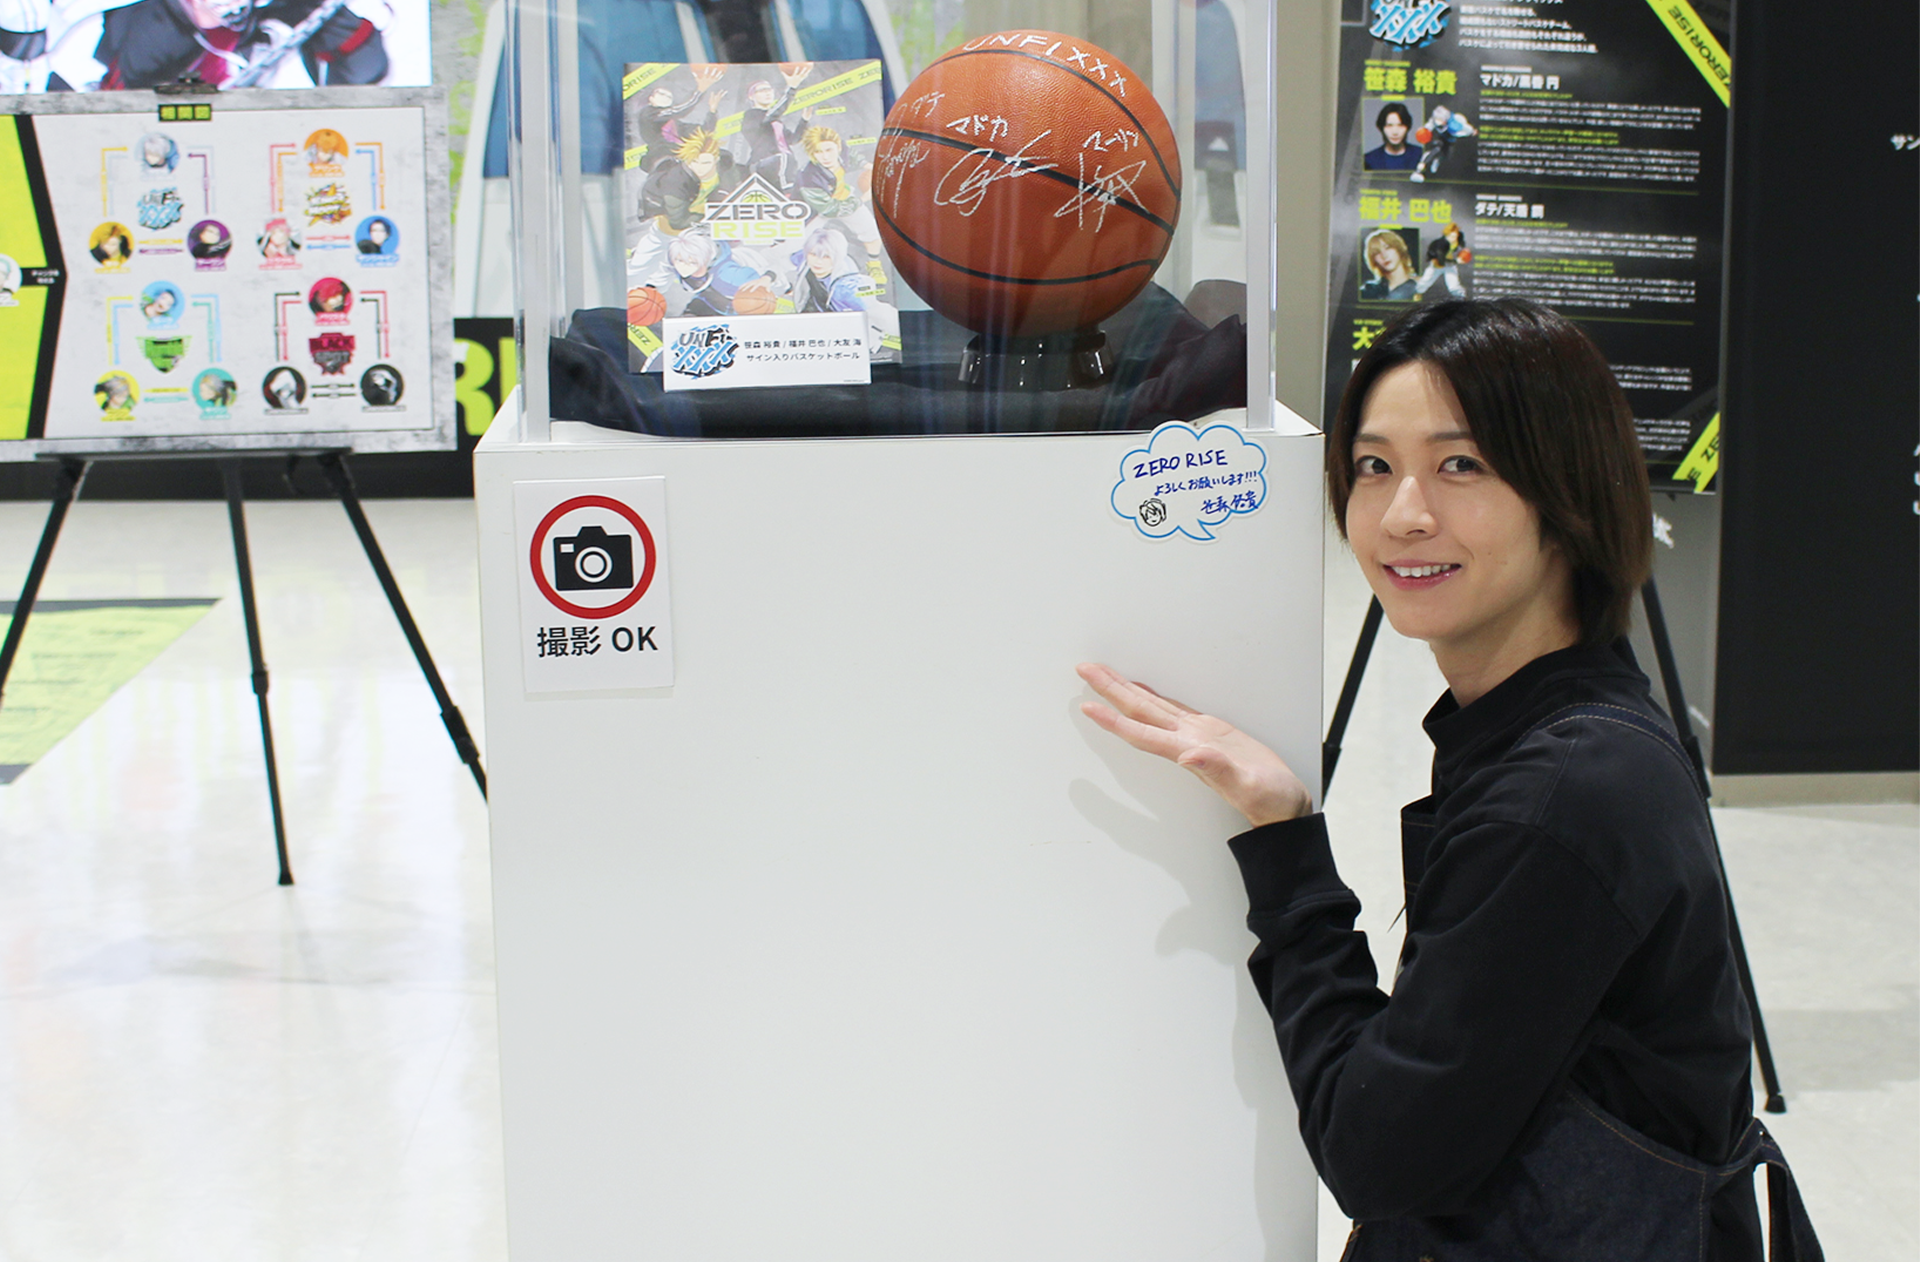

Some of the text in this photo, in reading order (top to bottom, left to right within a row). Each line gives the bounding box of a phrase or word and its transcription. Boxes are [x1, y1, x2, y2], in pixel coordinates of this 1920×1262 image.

[963, 34, 1127, 97] UNFIXXX
[946, 115, 1009, 142] マドカ
[706, 202, 810, 221] ZERO
[1359, 196, 1452, 223] 福井 巴也
[713, 221, 803, 239] RISE
[746, 352, 860, 362] サイン入りバスケットボール
[1133, 450, 1228, 478] ZERO RISE
[537, 625, 658, 657] 撮影 OK
